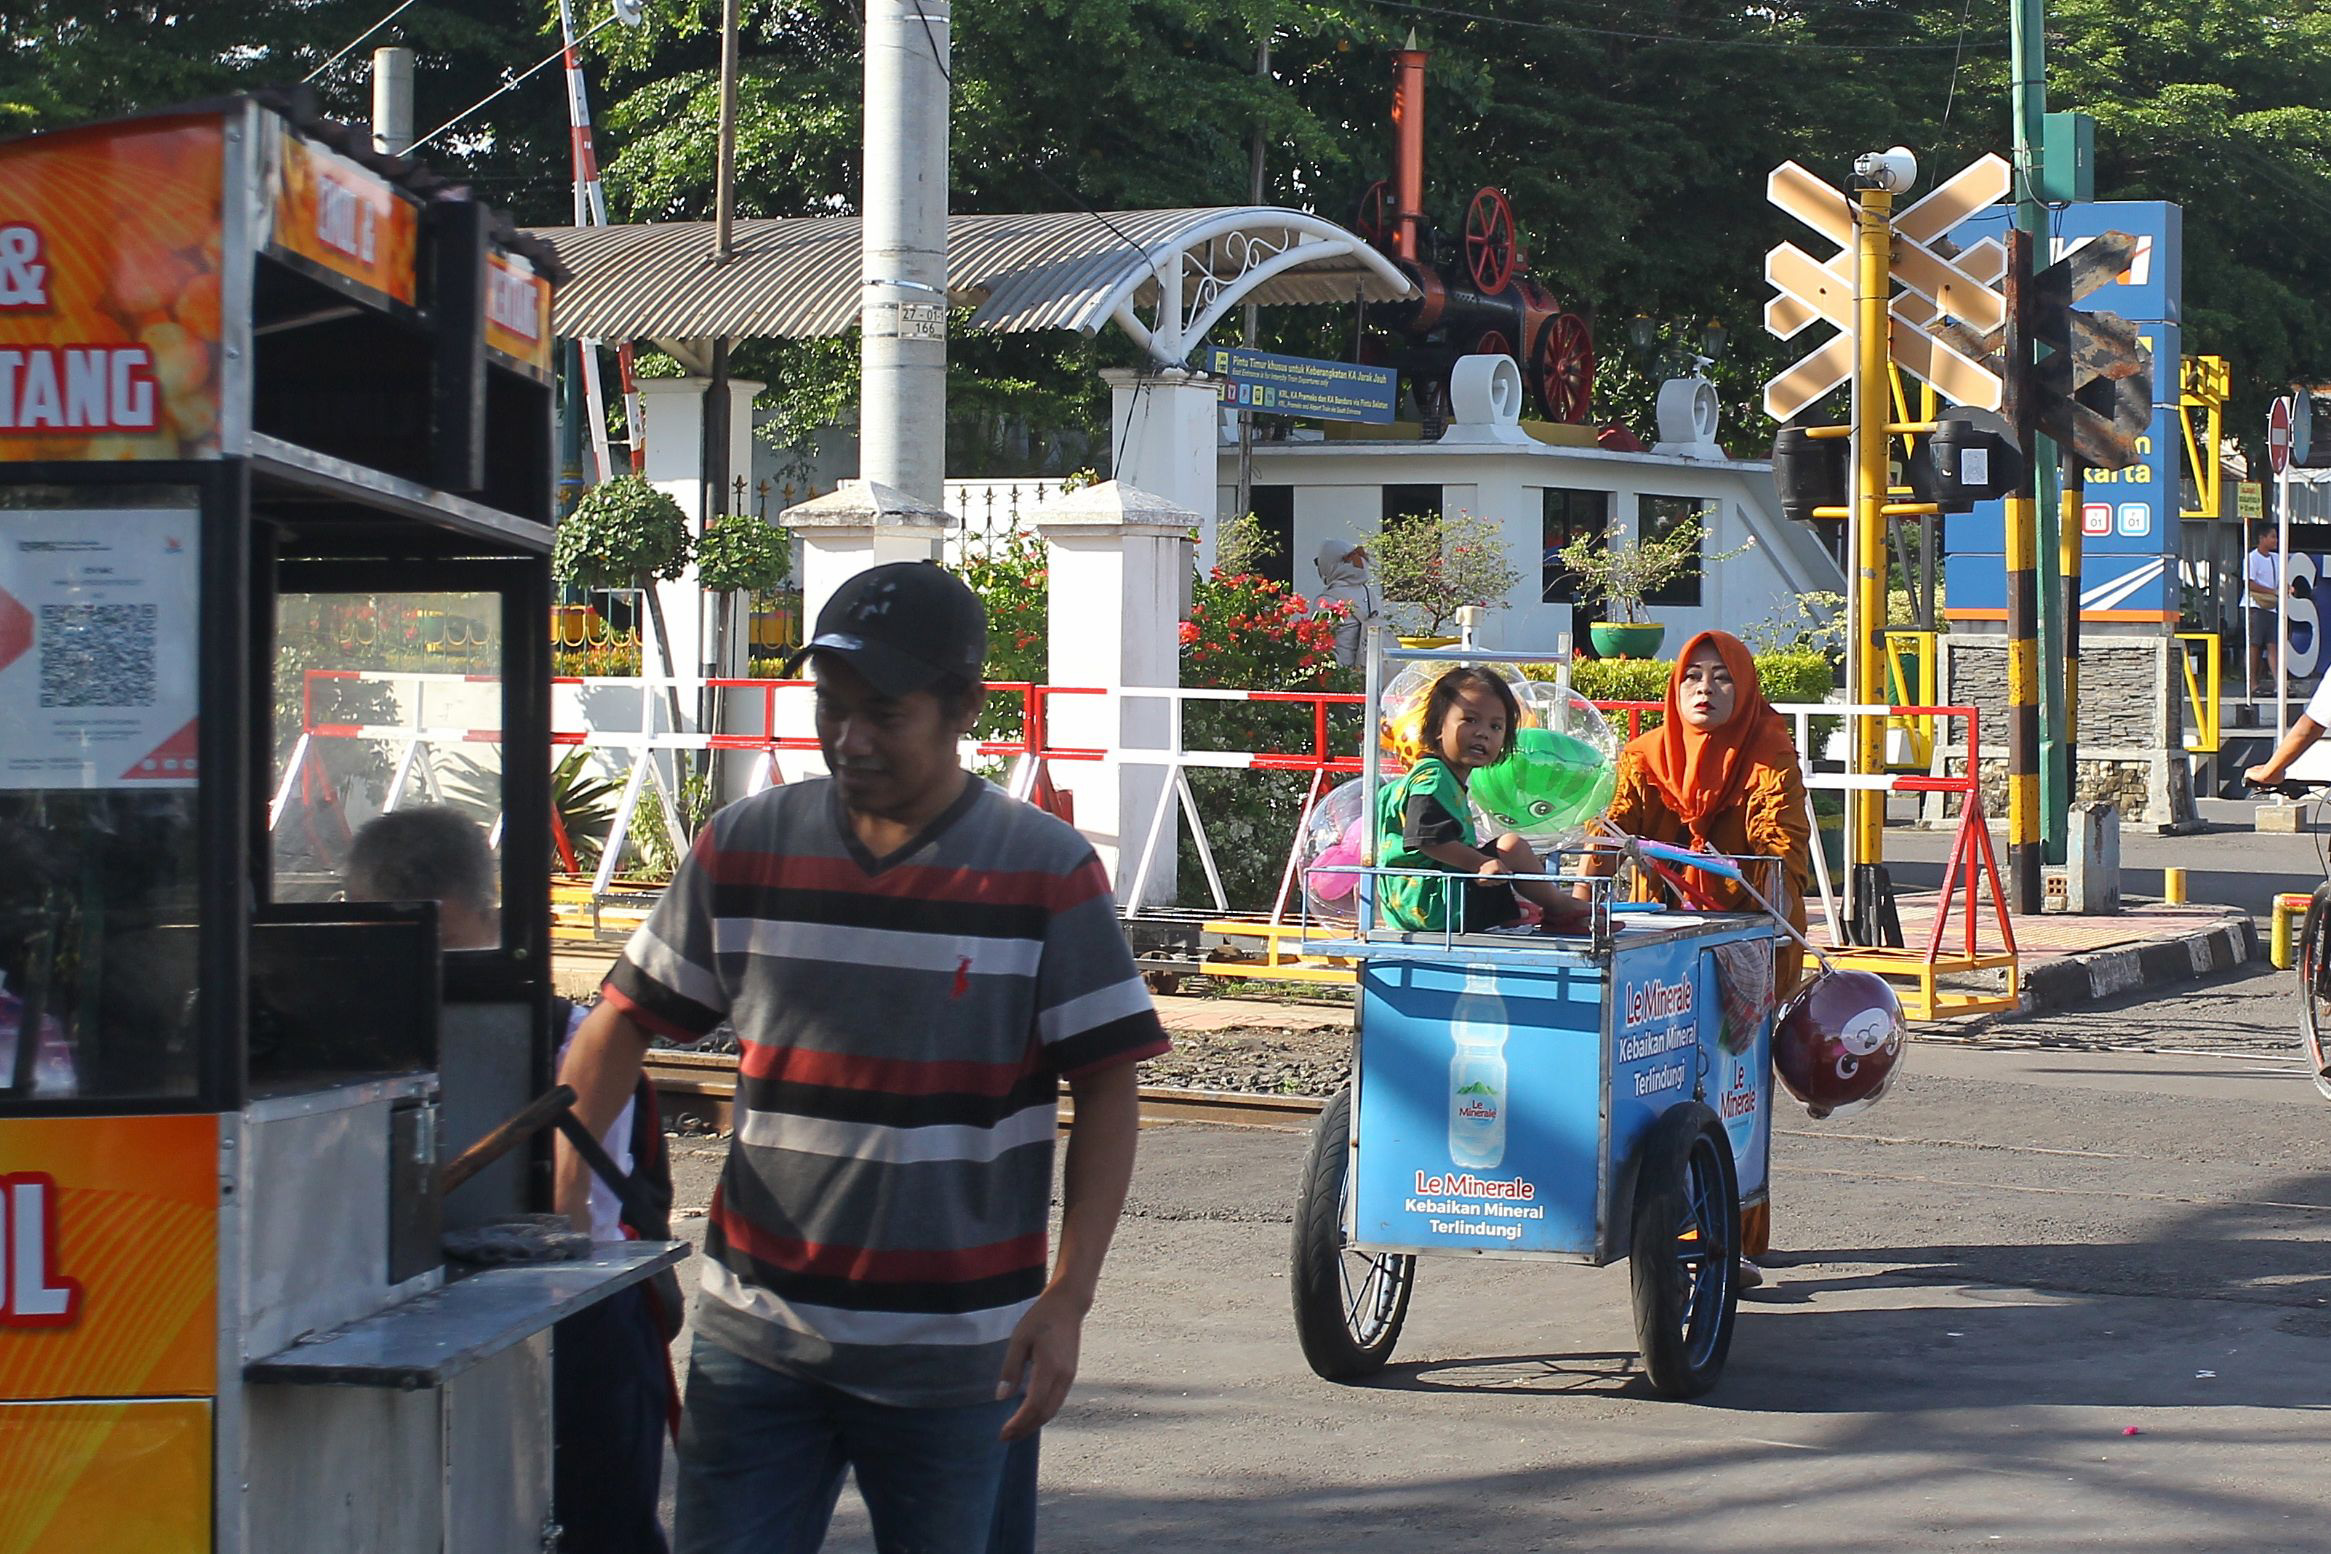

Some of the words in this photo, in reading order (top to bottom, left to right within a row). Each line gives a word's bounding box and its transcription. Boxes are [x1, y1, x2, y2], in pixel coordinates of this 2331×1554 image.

[0, 224, 48, 306] &
[903, 308, 916, 320] 27
[916, 322, 935, 334] 166
[1626, 982, 1642, 1028] Le
[1643, 971, 1692, 1023] Minerale
[1619, 1030, 1664, 1063] Kebaikan
[1666, 1018, 1696, 1050] Mineral
[1634, 1058, 1685, 1097] Terlindungi
[1733, 1059, 1745, 1090] Le
[1459, 1107, 1497, 1119] Minerale
[1472, 1099, 1483, 1109] Le
[1720, 1083, 1756, 1120] Minerale
[1415, 1169, 1442, 1197] Le
[1444, 1172, 1535, 1200] Minerale
[1405, 1199, 1480, 1216] Kebaikan
[1484, 1202, 1543, 1219] Mineral
[1430, 1219, 1522, 1240] Terlindungi
[0, 1183, 70, 1315] L
